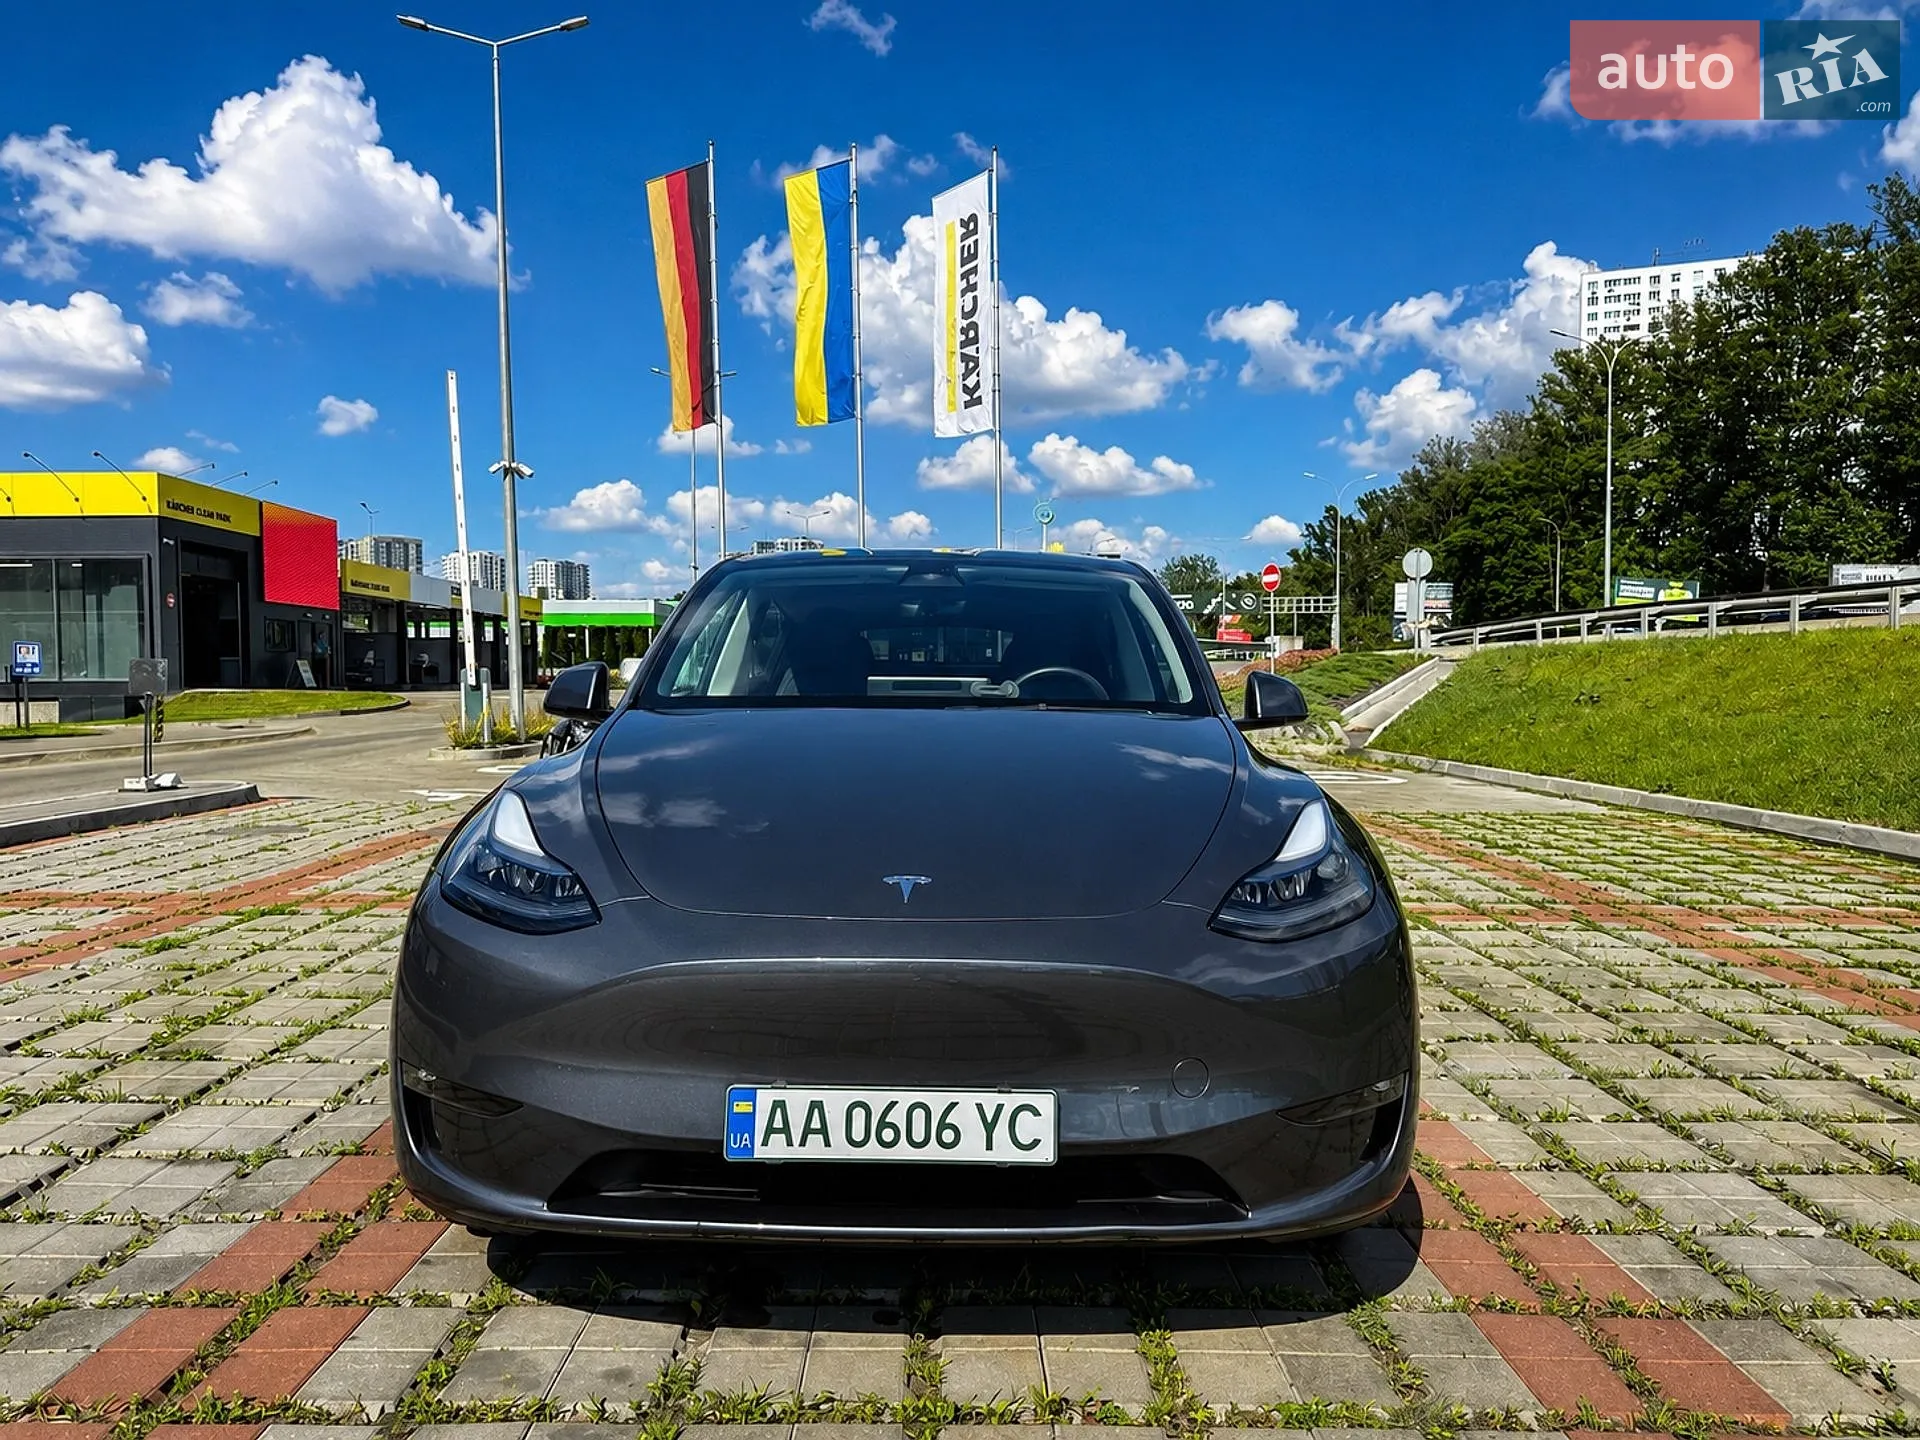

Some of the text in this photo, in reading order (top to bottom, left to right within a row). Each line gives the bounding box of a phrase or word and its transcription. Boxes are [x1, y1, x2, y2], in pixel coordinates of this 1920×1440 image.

[730, 1133, 752, 1149] UA
[761, 1099, 1043, 1151] AA 0606 YC
